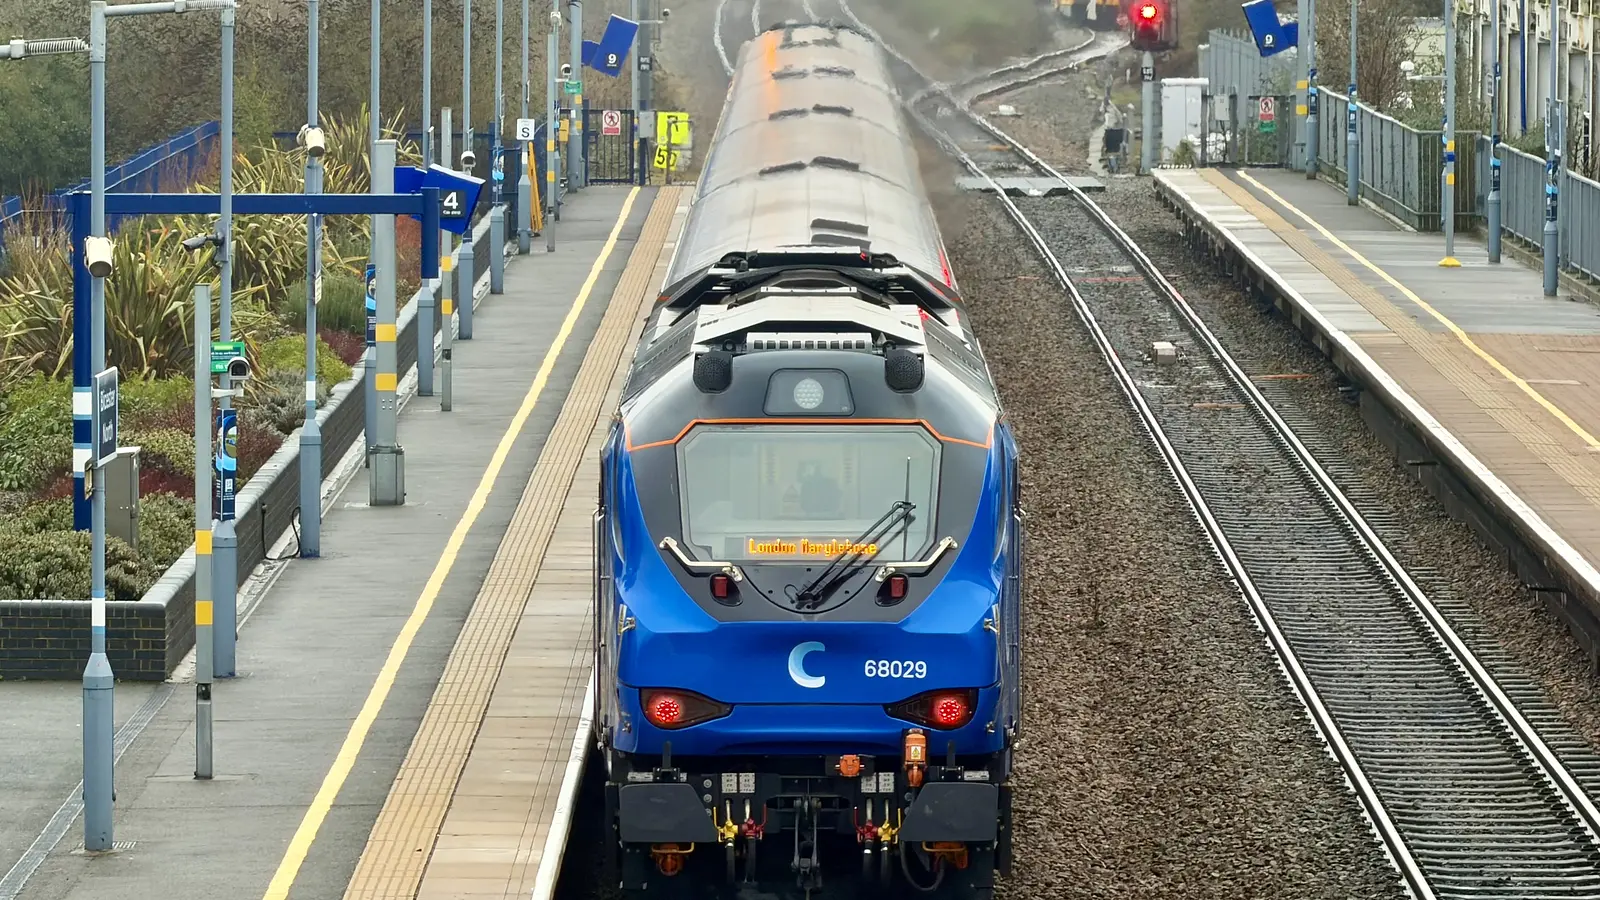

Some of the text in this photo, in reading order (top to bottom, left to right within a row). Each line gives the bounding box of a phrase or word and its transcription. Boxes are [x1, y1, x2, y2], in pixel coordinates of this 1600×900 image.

[1265, 34, 1273, 45] 9
[608, 53, 617, 64] 9
[521, 127, 530, 138] S
[443, 191, 459, 209] 4
[100, 388, 116, 412] Bicester
[102, 419, 114, 444] North
[748, 538, 797, 554] London
[864, 659, 927, 679] 68029
